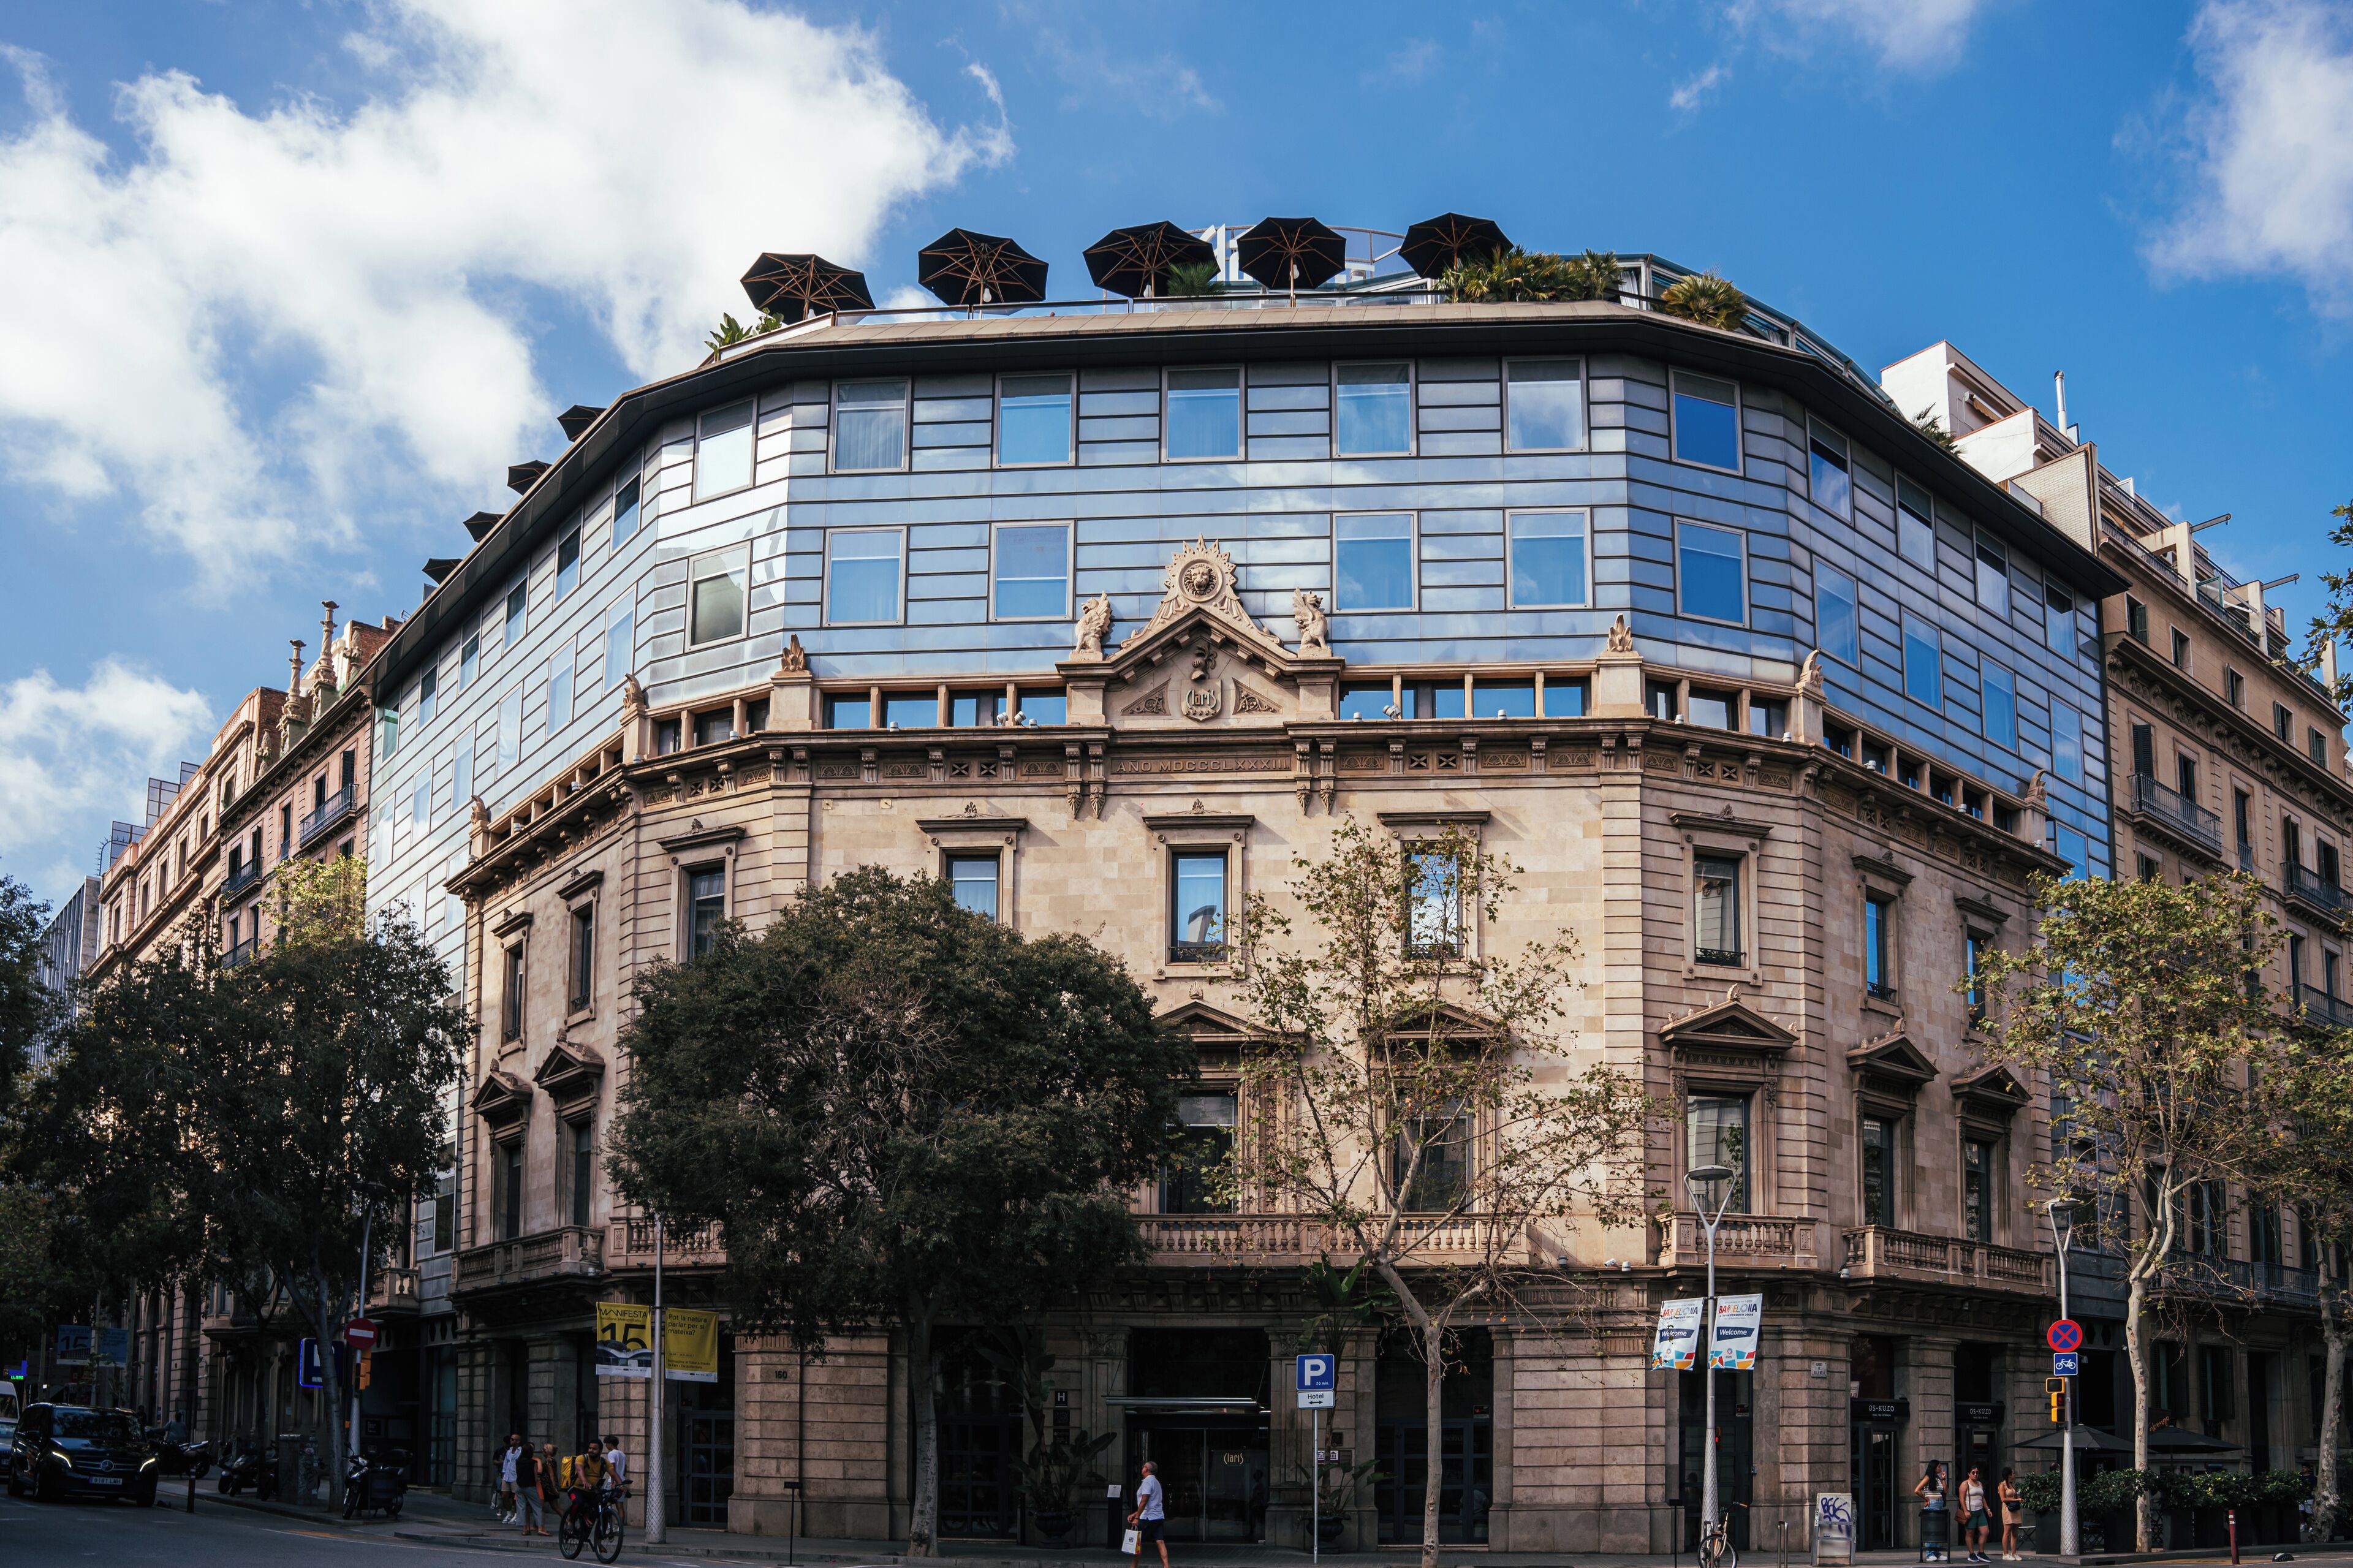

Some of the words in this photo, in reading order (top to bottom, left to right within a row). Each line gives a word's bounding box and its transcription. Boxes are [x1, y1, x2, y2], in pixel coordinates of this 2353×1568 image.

[1116, 760, 1152, 773] AÑO
[600, 1308, 648, 1318] MANIFESTA
[601, 1323, 648, 1350] 15
[1305, 1359, 1326, 1385] P
[1058, 1392, 1065, 1401] H
[2149, 1416, 2170, 1432] abongo
